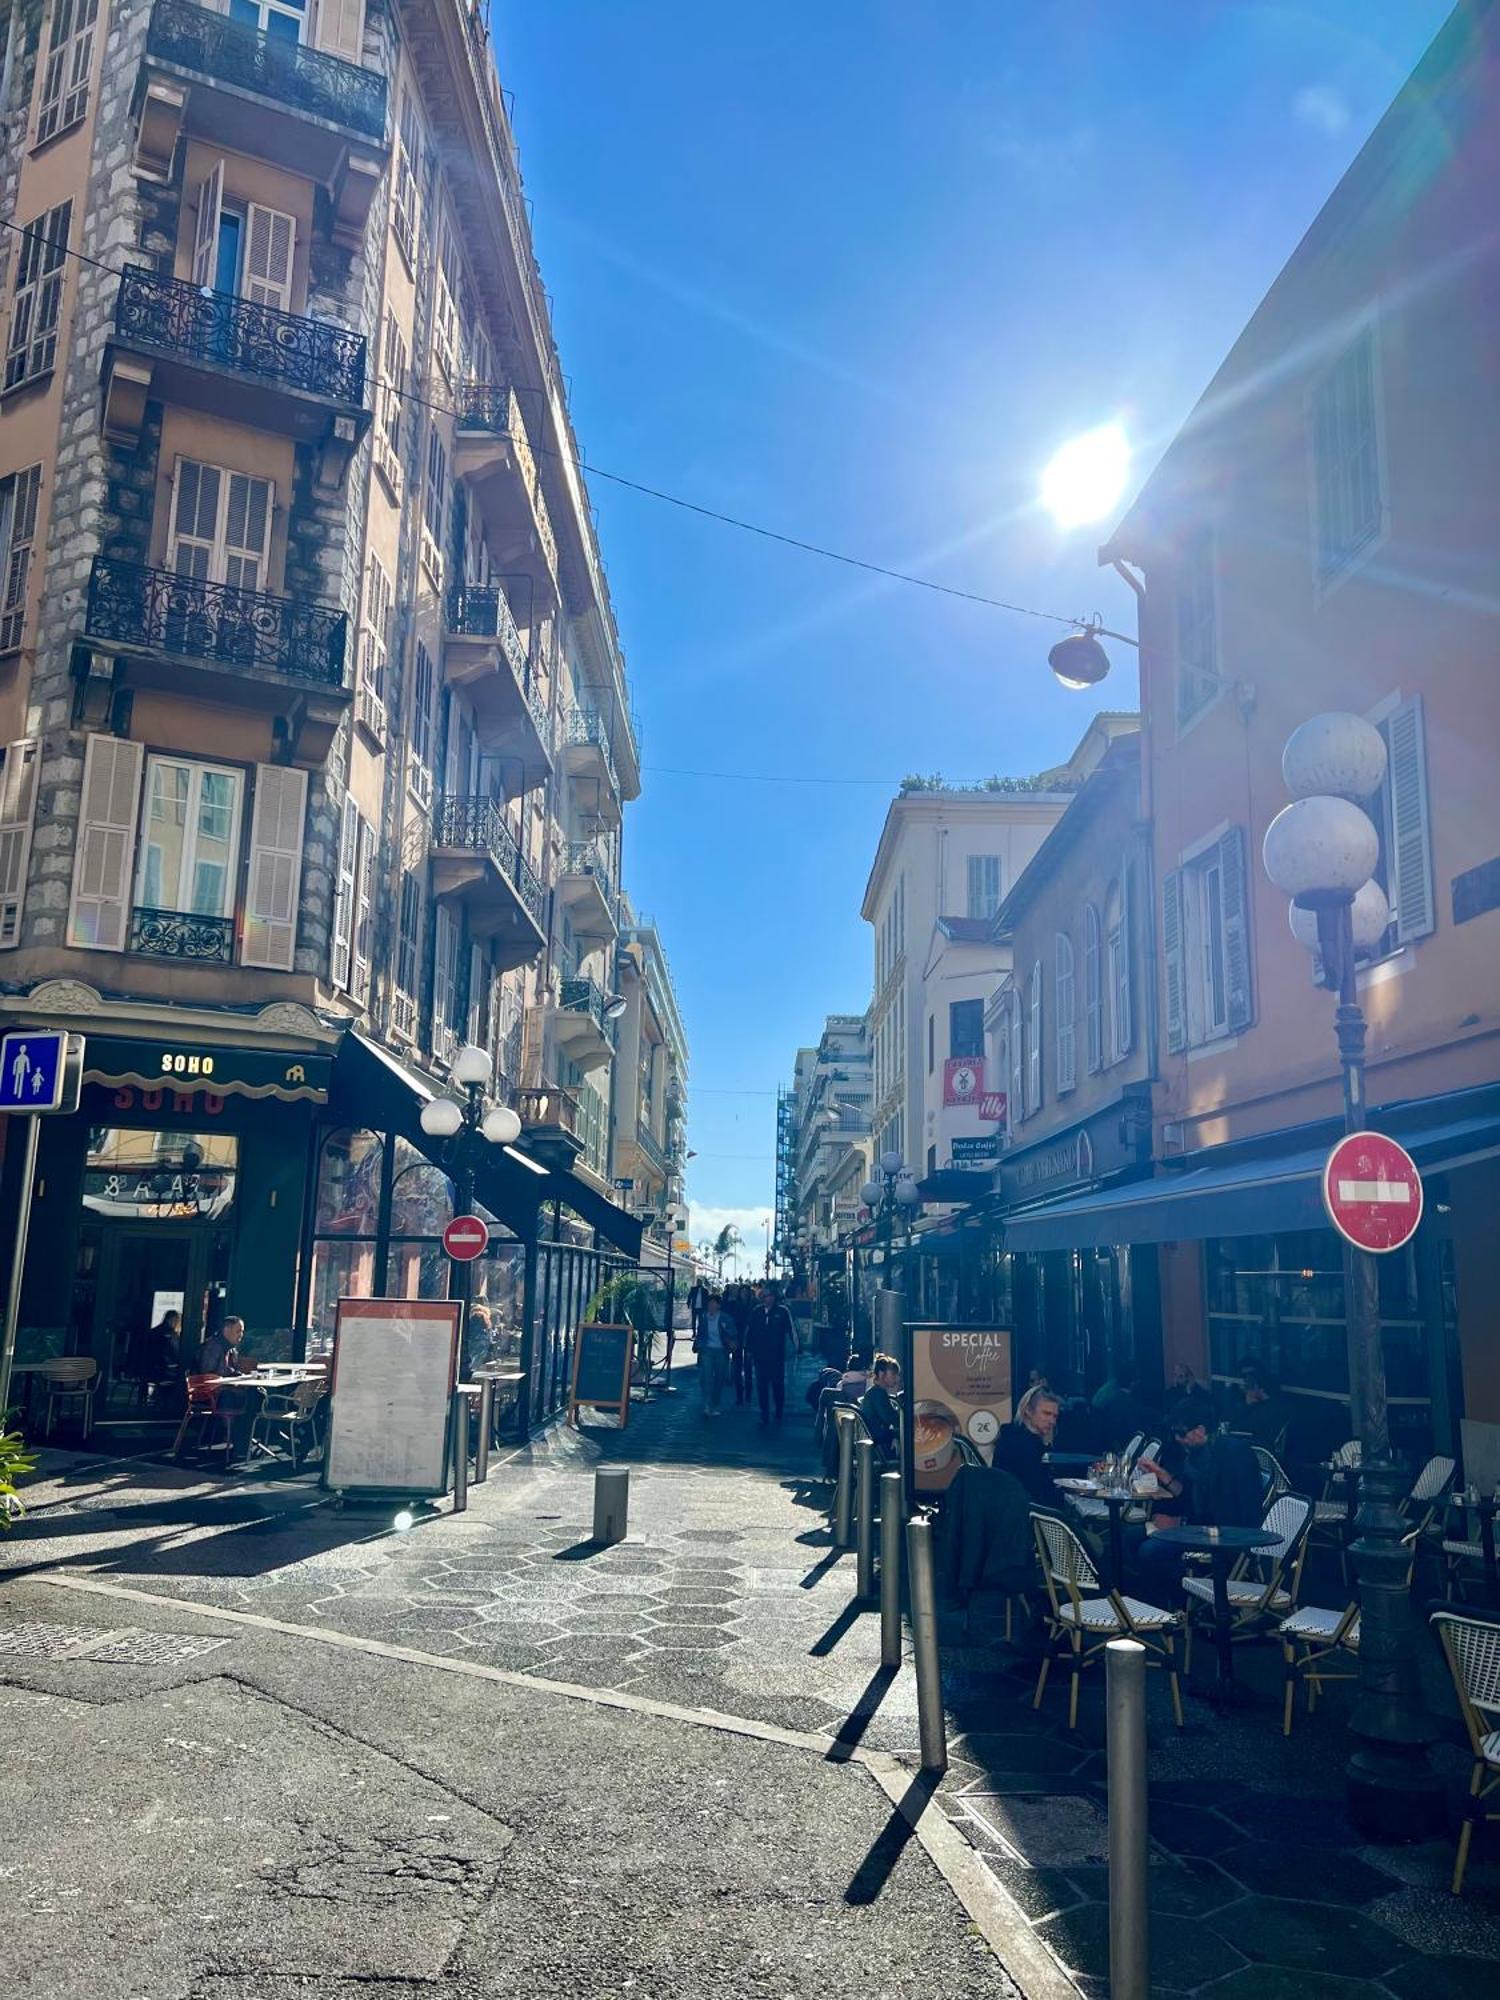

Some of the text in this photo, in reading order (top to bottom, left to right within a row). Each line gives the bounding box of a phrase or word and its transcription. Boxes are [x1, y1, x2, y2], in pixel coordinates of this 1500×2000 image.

[161, 1053, 214, 1075] SOHO
[979, 1095, 1006, 1119] illy
[943, 1332, 1001, 1347] SPECIAL
[964, 1342, 1001, 1372] Coffee
[976, 1422, 991, 1433] 2€
